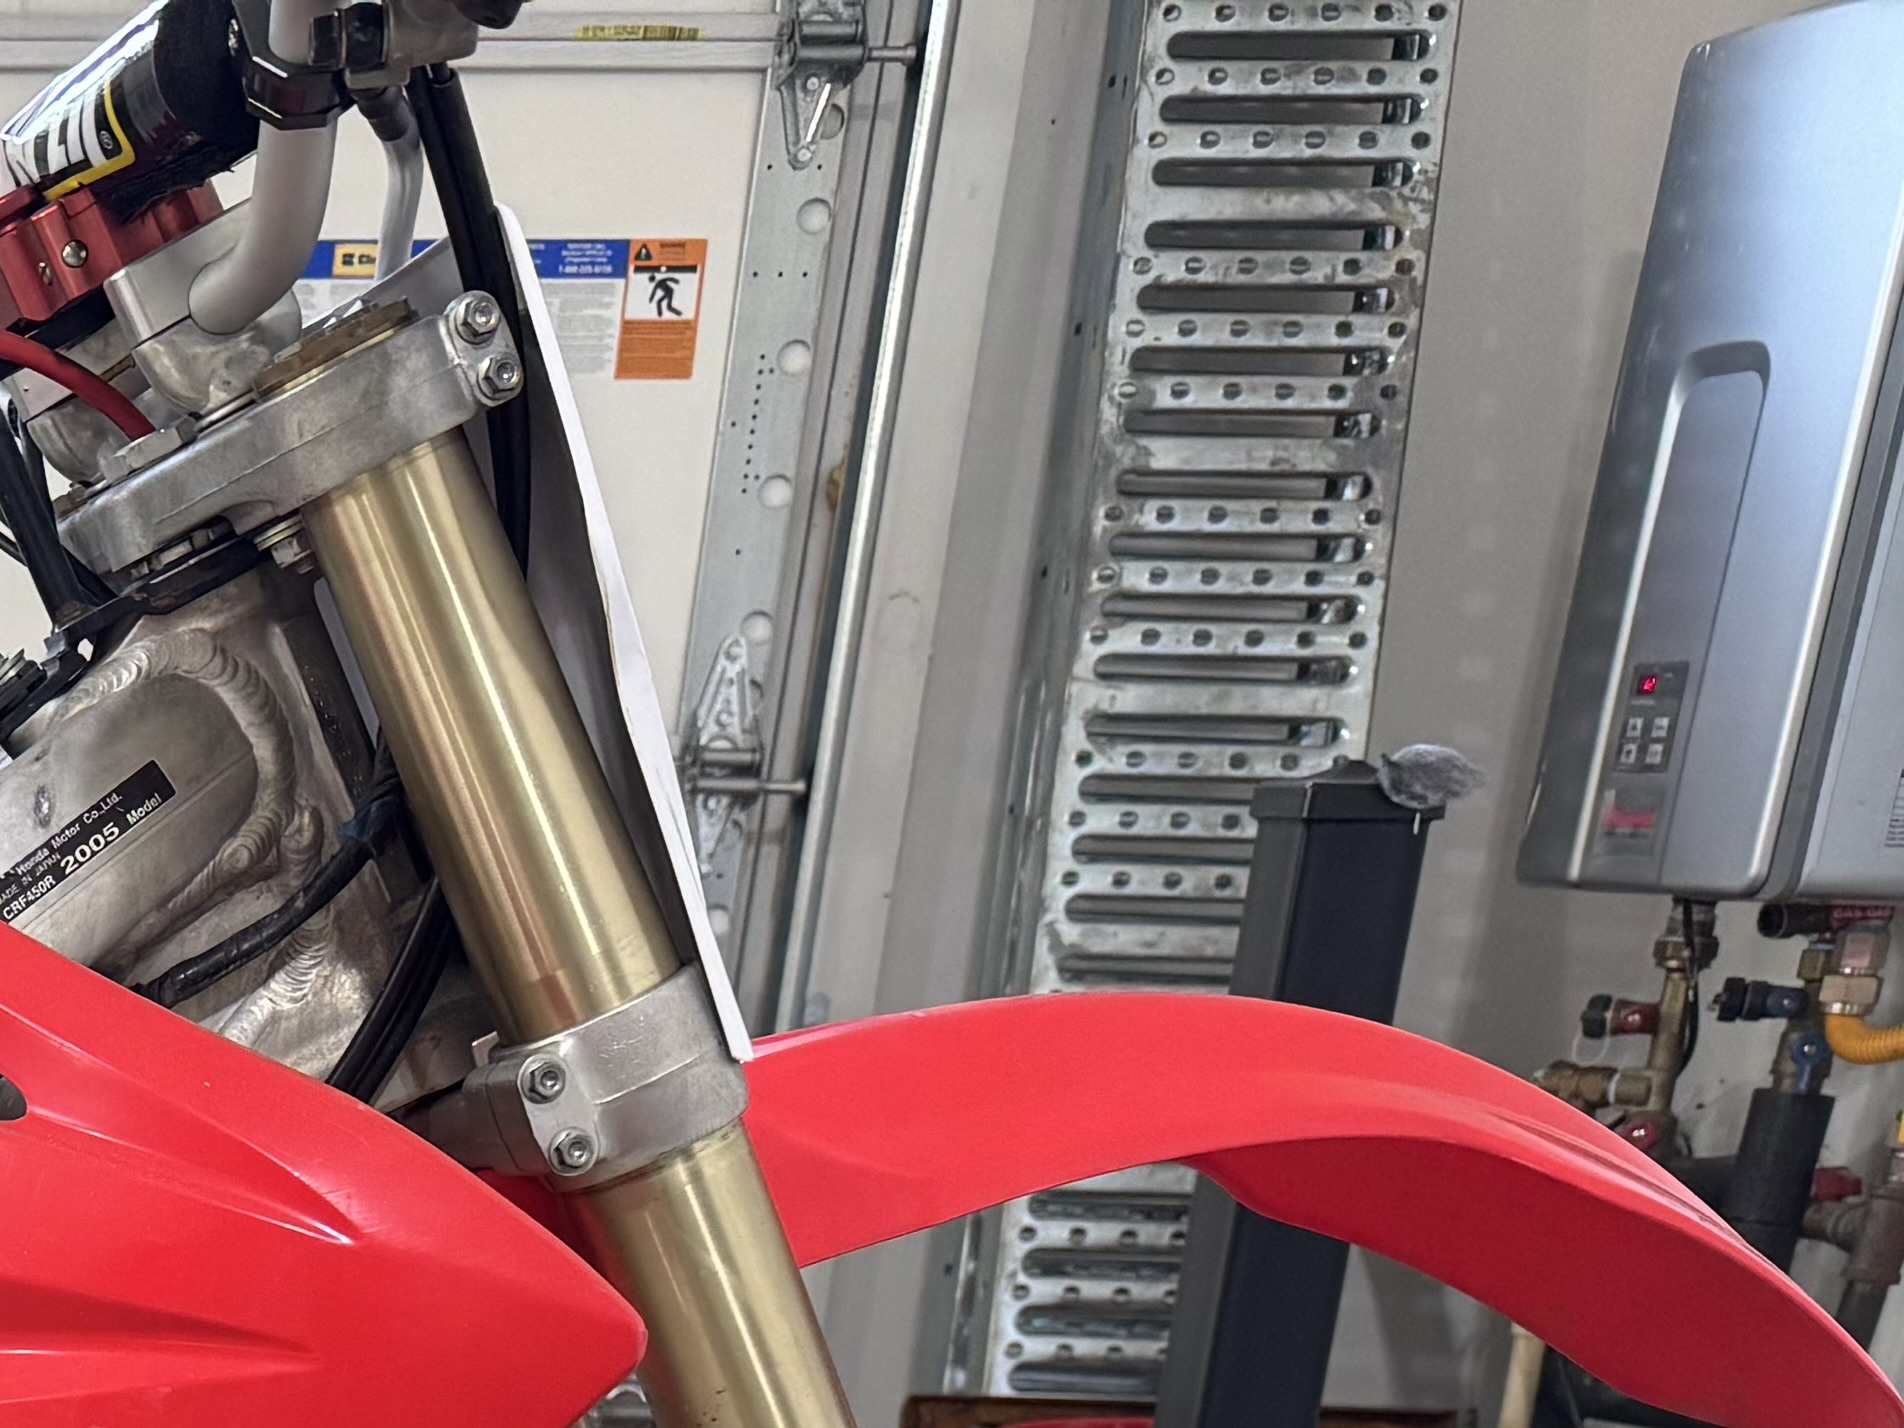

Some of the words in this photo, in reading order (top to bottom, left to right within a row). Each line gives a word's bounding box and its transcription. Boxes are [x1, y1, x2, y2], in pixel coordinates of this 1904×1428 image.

[2, 874, 57, 921] CRF450R
[60, 822, 121, 876] 2005
[125, 794, 162, 826] Model
[14, 845, 50, 877] Honda
[51, 822, 82, 849] Motor
[22, 874, 33, 887] IN
